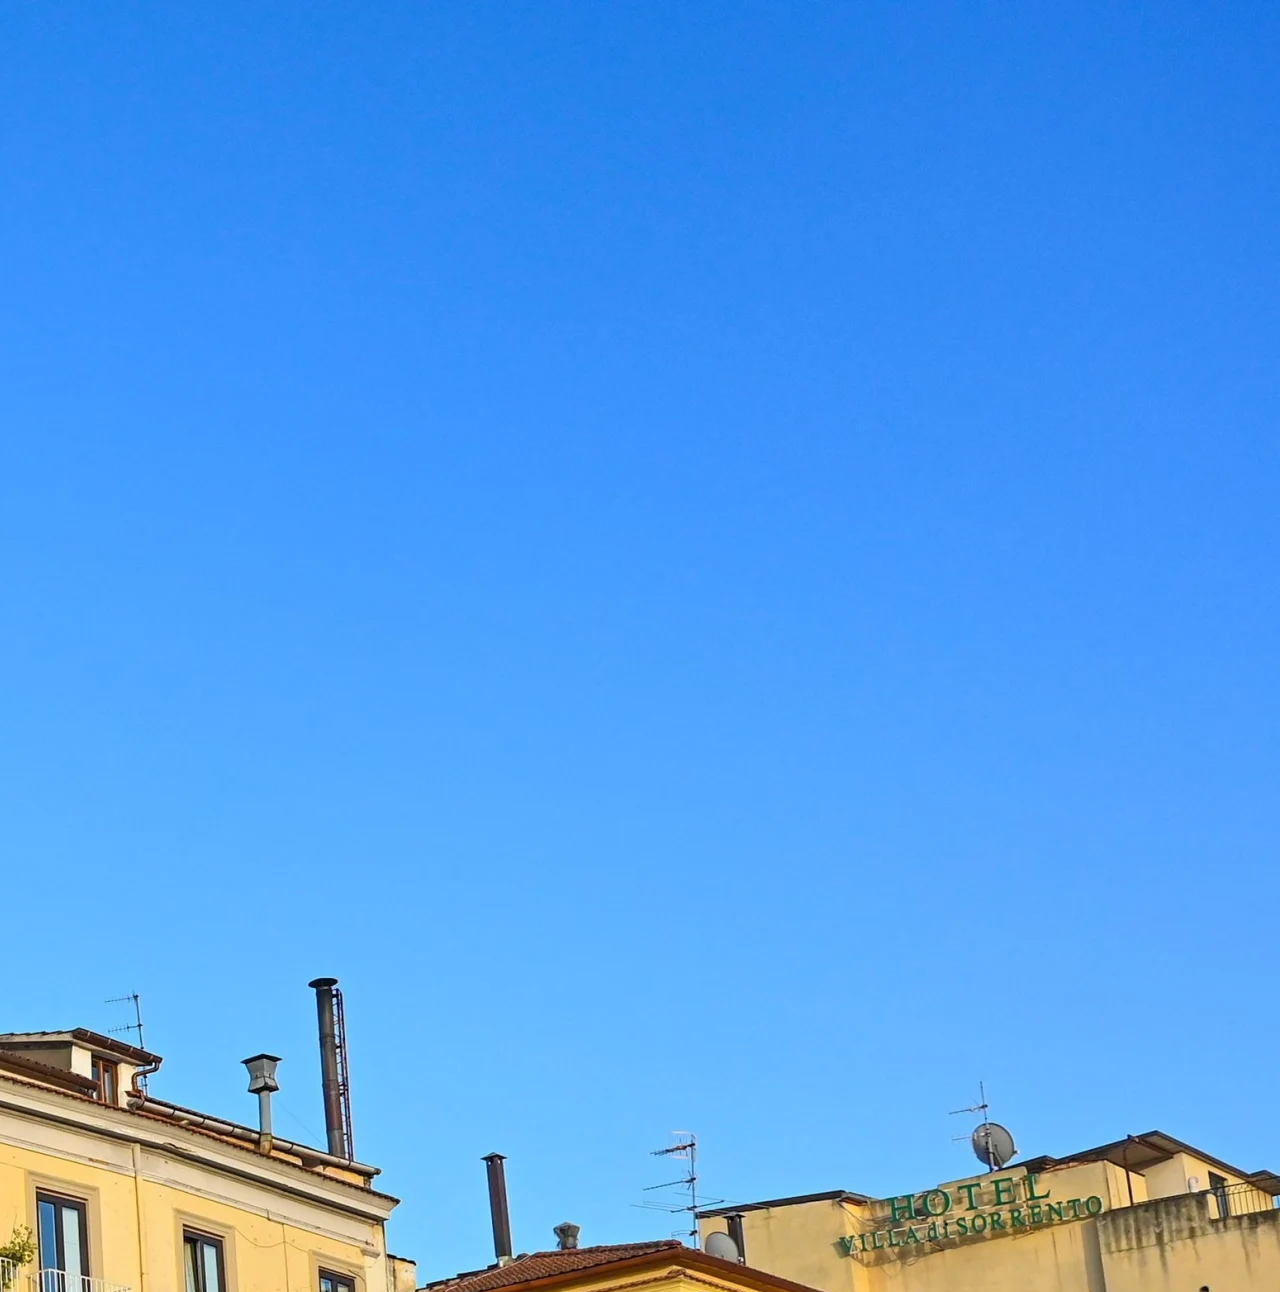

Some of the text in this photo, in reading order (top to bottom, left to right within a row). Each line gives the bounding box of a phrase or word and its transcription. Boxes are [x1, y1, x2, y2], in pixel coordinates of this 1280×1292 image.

[839, 1195, 1104, 1254] VILLA di SORRENTO
[891, 1173, 1051, 1223] HOTEL
